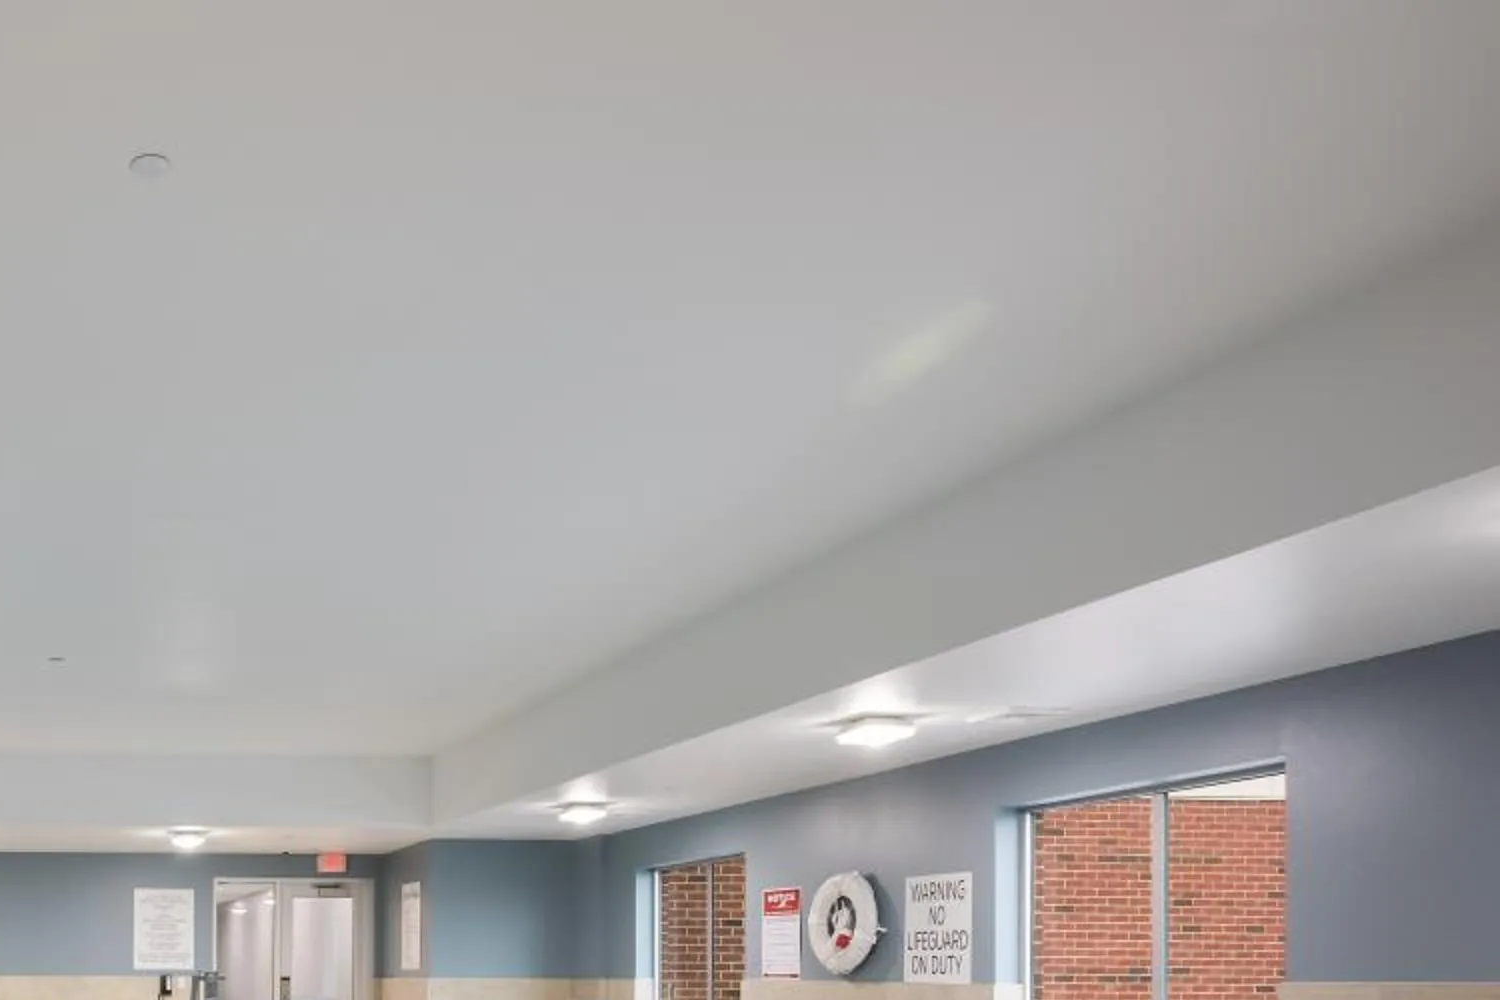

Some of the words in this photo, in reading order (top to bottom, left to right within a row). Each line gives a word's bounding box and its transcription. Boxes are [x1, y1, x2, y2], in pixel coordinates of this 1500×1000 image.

[910, 880, 965, 902] WARNING
[928, 905, 946, 926] NO
[907, 930, 969, 951] LIFEGUARD
[911, 955, 928, 975] ON
[931, 954, 963, 975] DUTY
